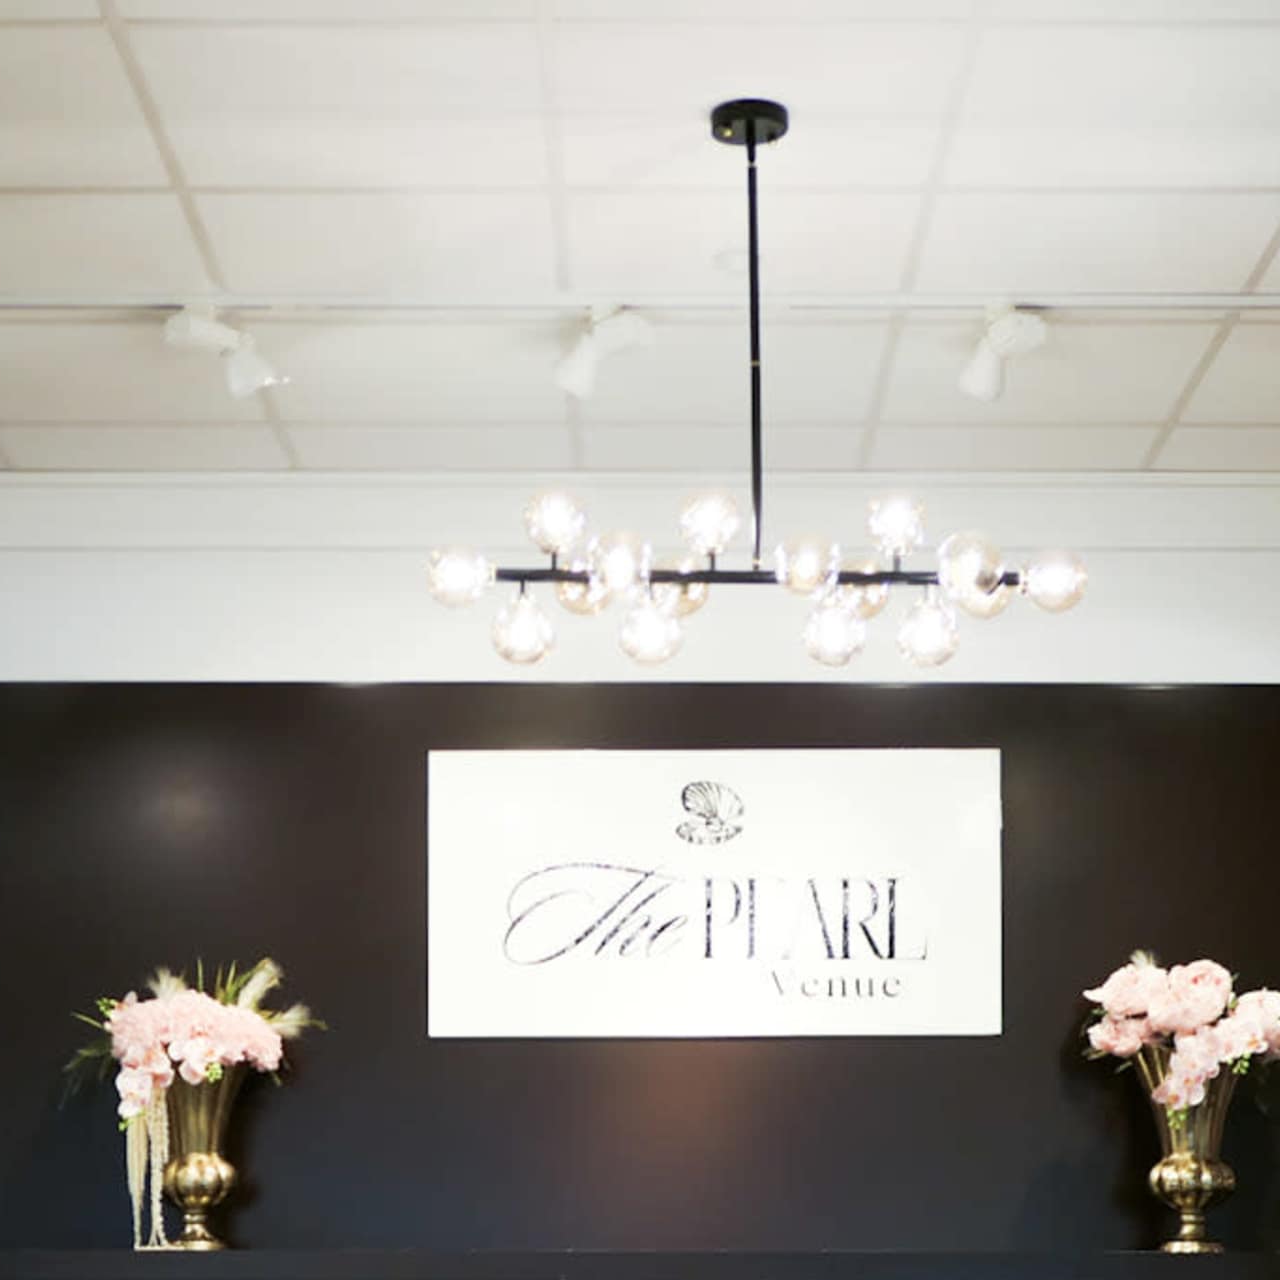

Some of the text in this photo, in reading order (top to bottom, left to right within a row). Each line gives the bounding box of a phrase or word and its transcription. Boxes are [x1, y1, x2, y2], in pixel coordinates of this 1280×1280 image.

[503, 862, 928, 966] The PEARL
[768, 969, 903, 999] Venue
